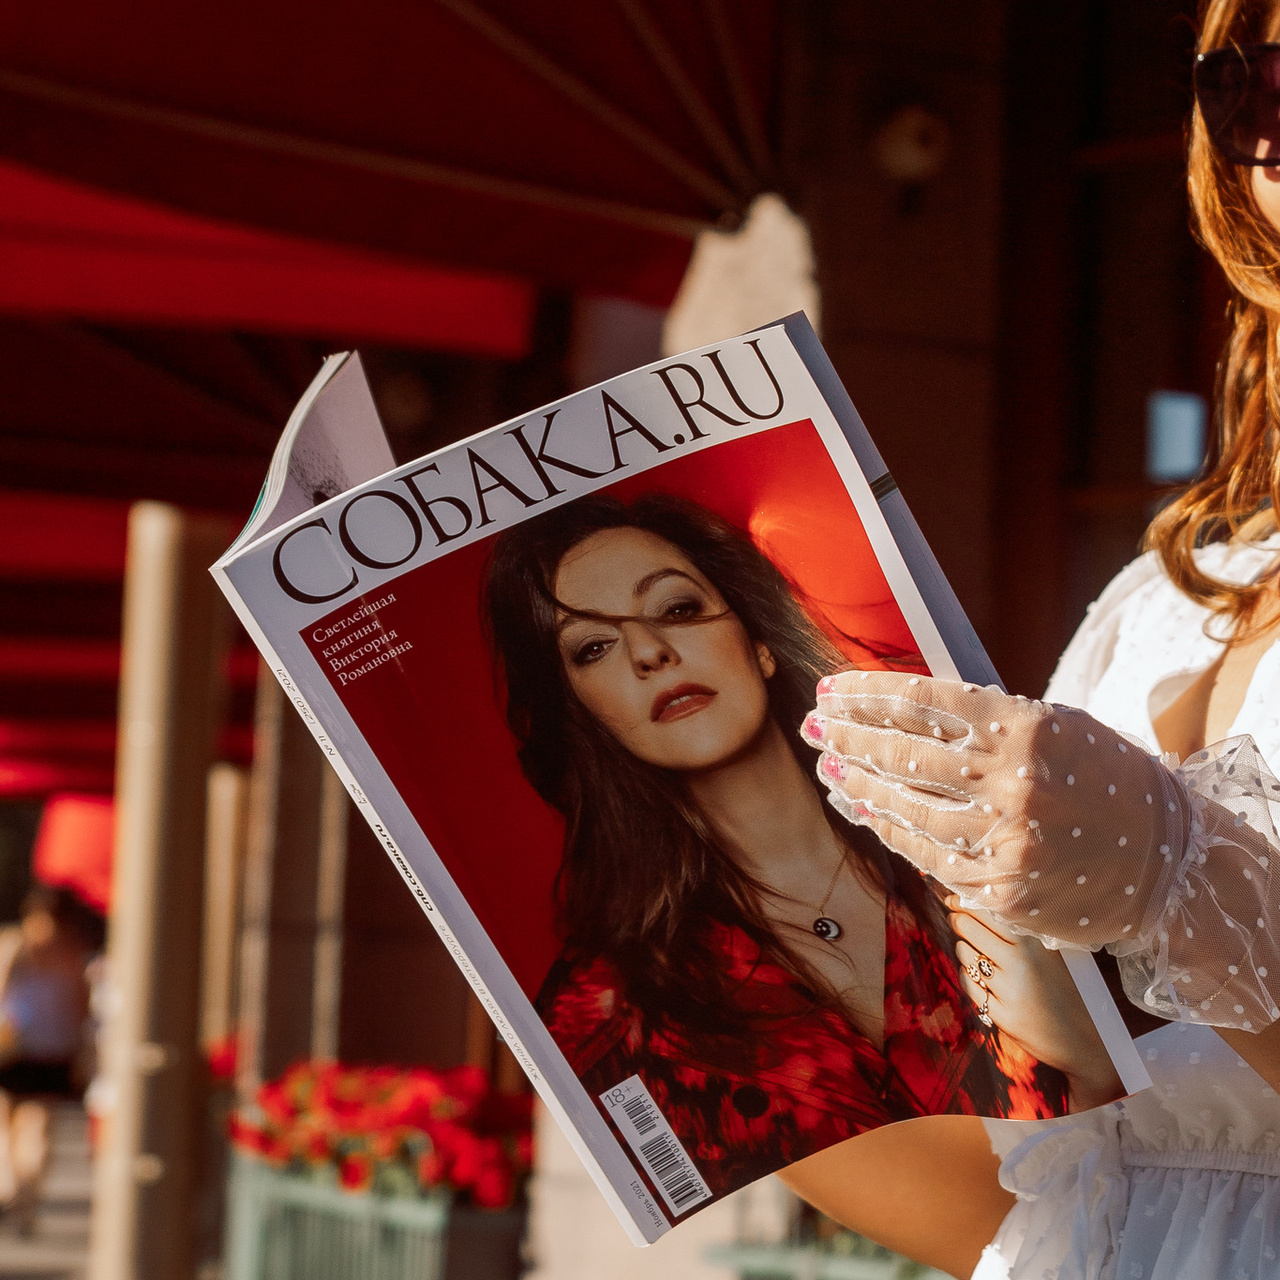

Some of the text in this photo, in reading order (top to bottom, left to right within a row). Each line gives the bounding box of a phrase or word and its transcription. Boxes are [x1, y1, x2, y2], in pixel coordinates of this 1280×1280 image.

[272, 339, 785, 605] СОБАКА.RU
[312, 593, 397, 642] Светлейшая
[322, 620, 381, 658] княгиня
[328, 630, 398, 672] Виктория
[276, 669, 296, 692] 2021
[337, 641, 413, 686] Романовна
[294, 696, 315, 725] (250)
[639, 1093, 660, 1121] 21011
[630, 1180, 663, 1228] Ноябрь 2021
